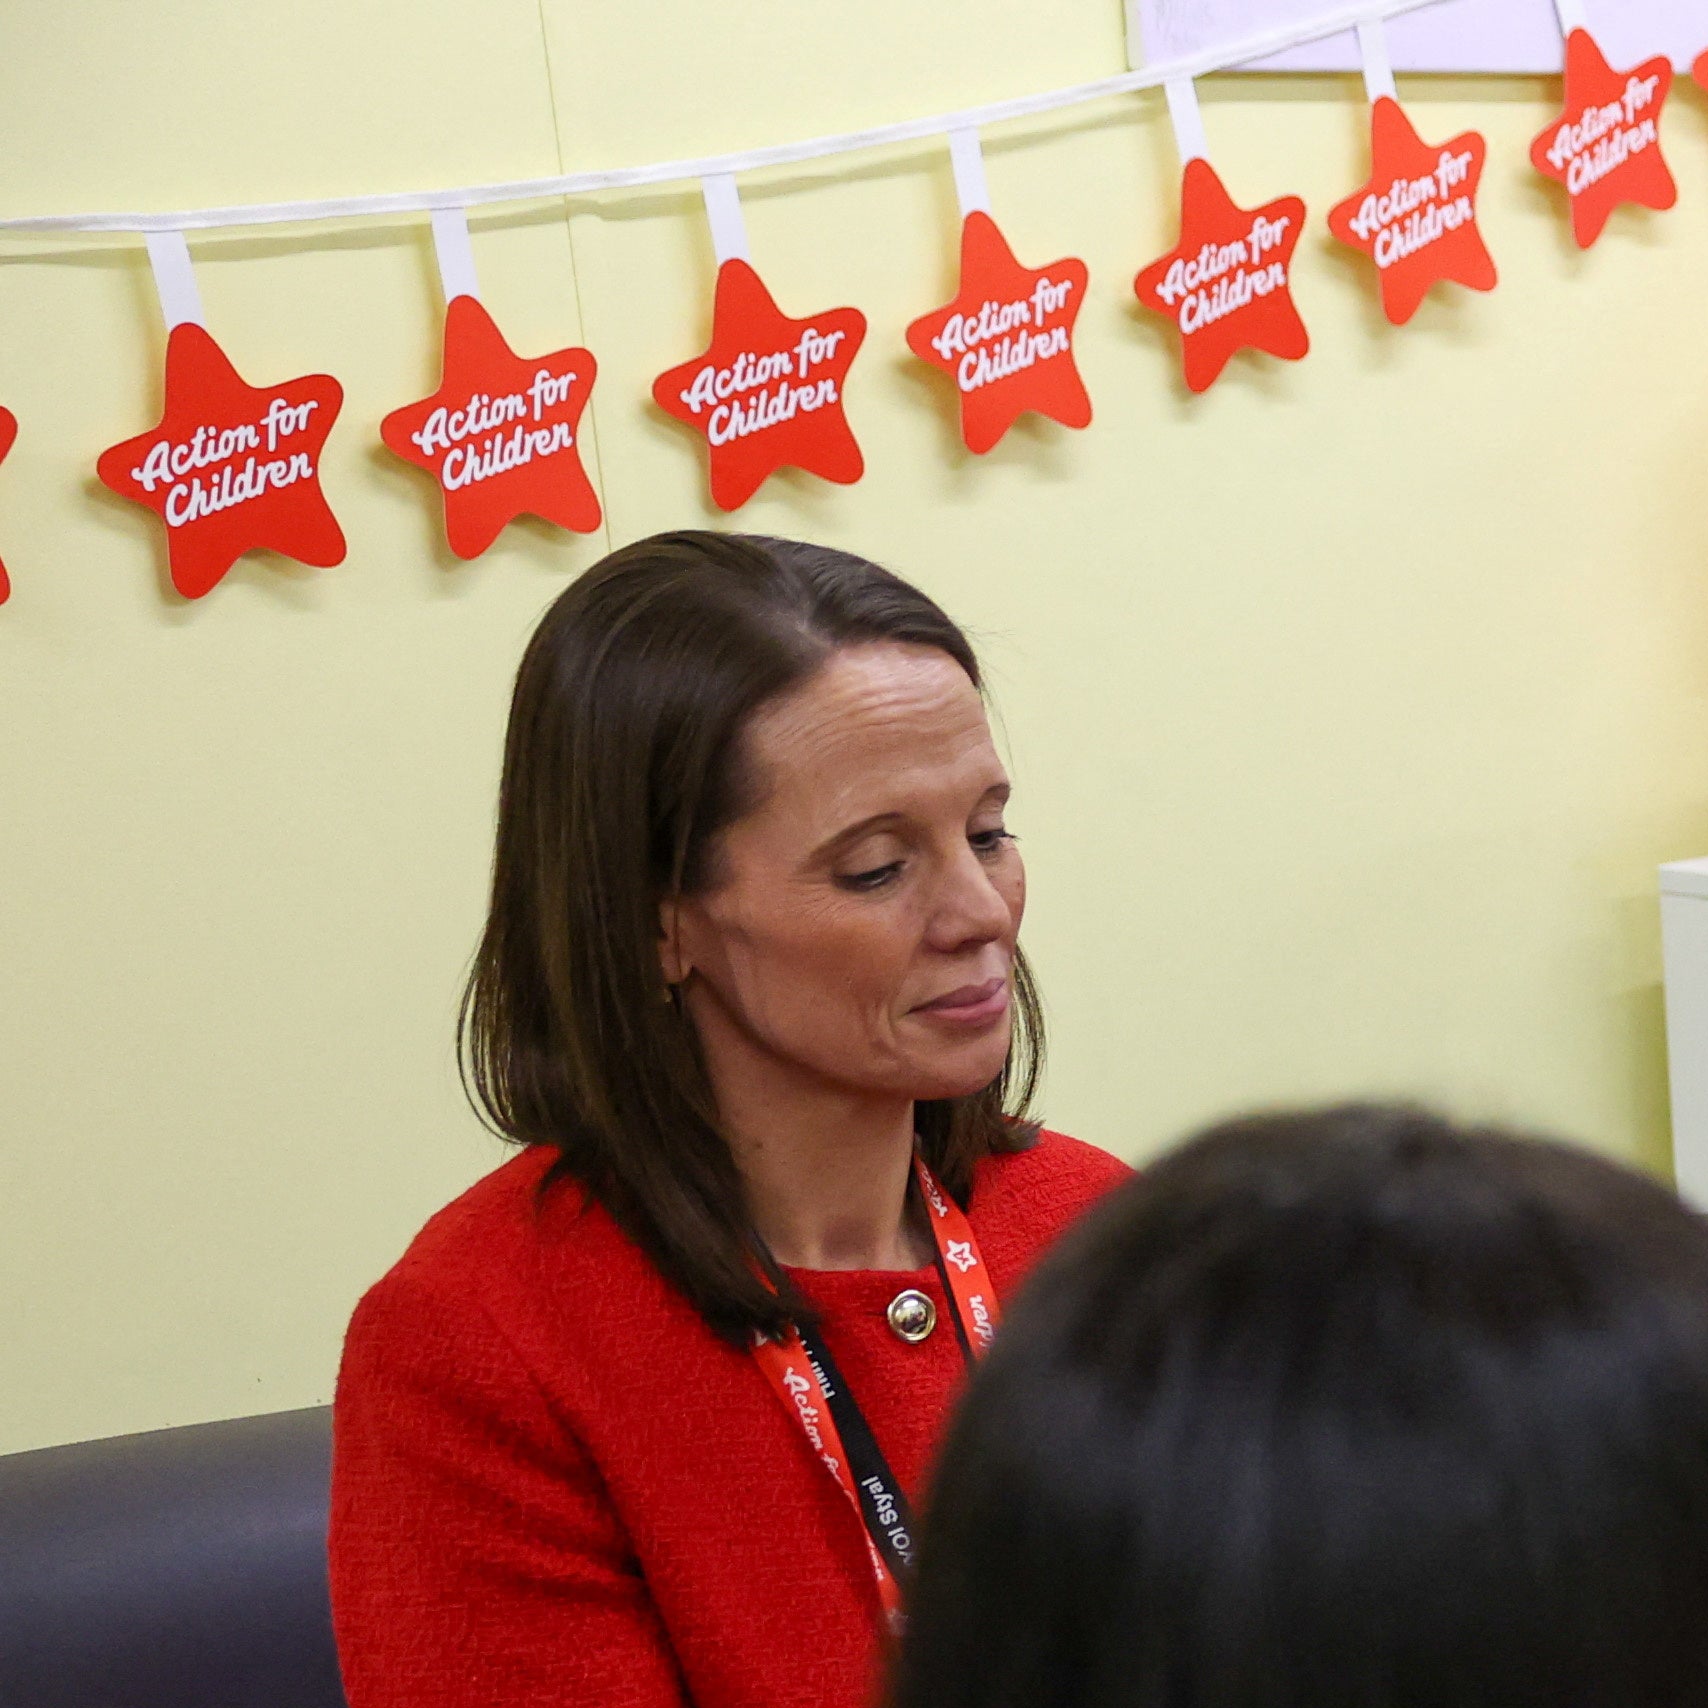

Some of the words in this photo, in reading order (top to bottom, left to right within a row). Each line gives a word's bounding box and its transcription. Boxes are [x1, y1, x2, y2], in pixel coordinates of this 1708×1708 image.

[1546, 101, 1623, 170] Action
[1621, 74, 1660, 124] for
[1567, 118, 1657, 196] Children
[1348, 175, 1438, 240] Action
[1433, 151, 1473, 200] for
[1374, 196, 1474, 269] Children
[1156, 240, 1248, 305] Action
[1246, 216, 1290, 265] for
[1180, 262, 1286, 334] Children
[931, 300, 1031, 360] Action
[1029, 277, 1072, 327] for
[680, 352, 793, 413] Action
[793, 328, 845, 378] for
[958, 326, 1069, 392] Children
[131, 425, 260, 492] Action
[260, 398, 318, 452] for
[412, 394, 527, 455] Action
[526, 369, 576, 421] for
[708, 378, 838, 446] Children
[166, 452, 312, 526] Children
[442, 422, 572, 490] Children
[783, 1366, 824, 1450] Action
[861, 1475, 899, 1525] Styal
